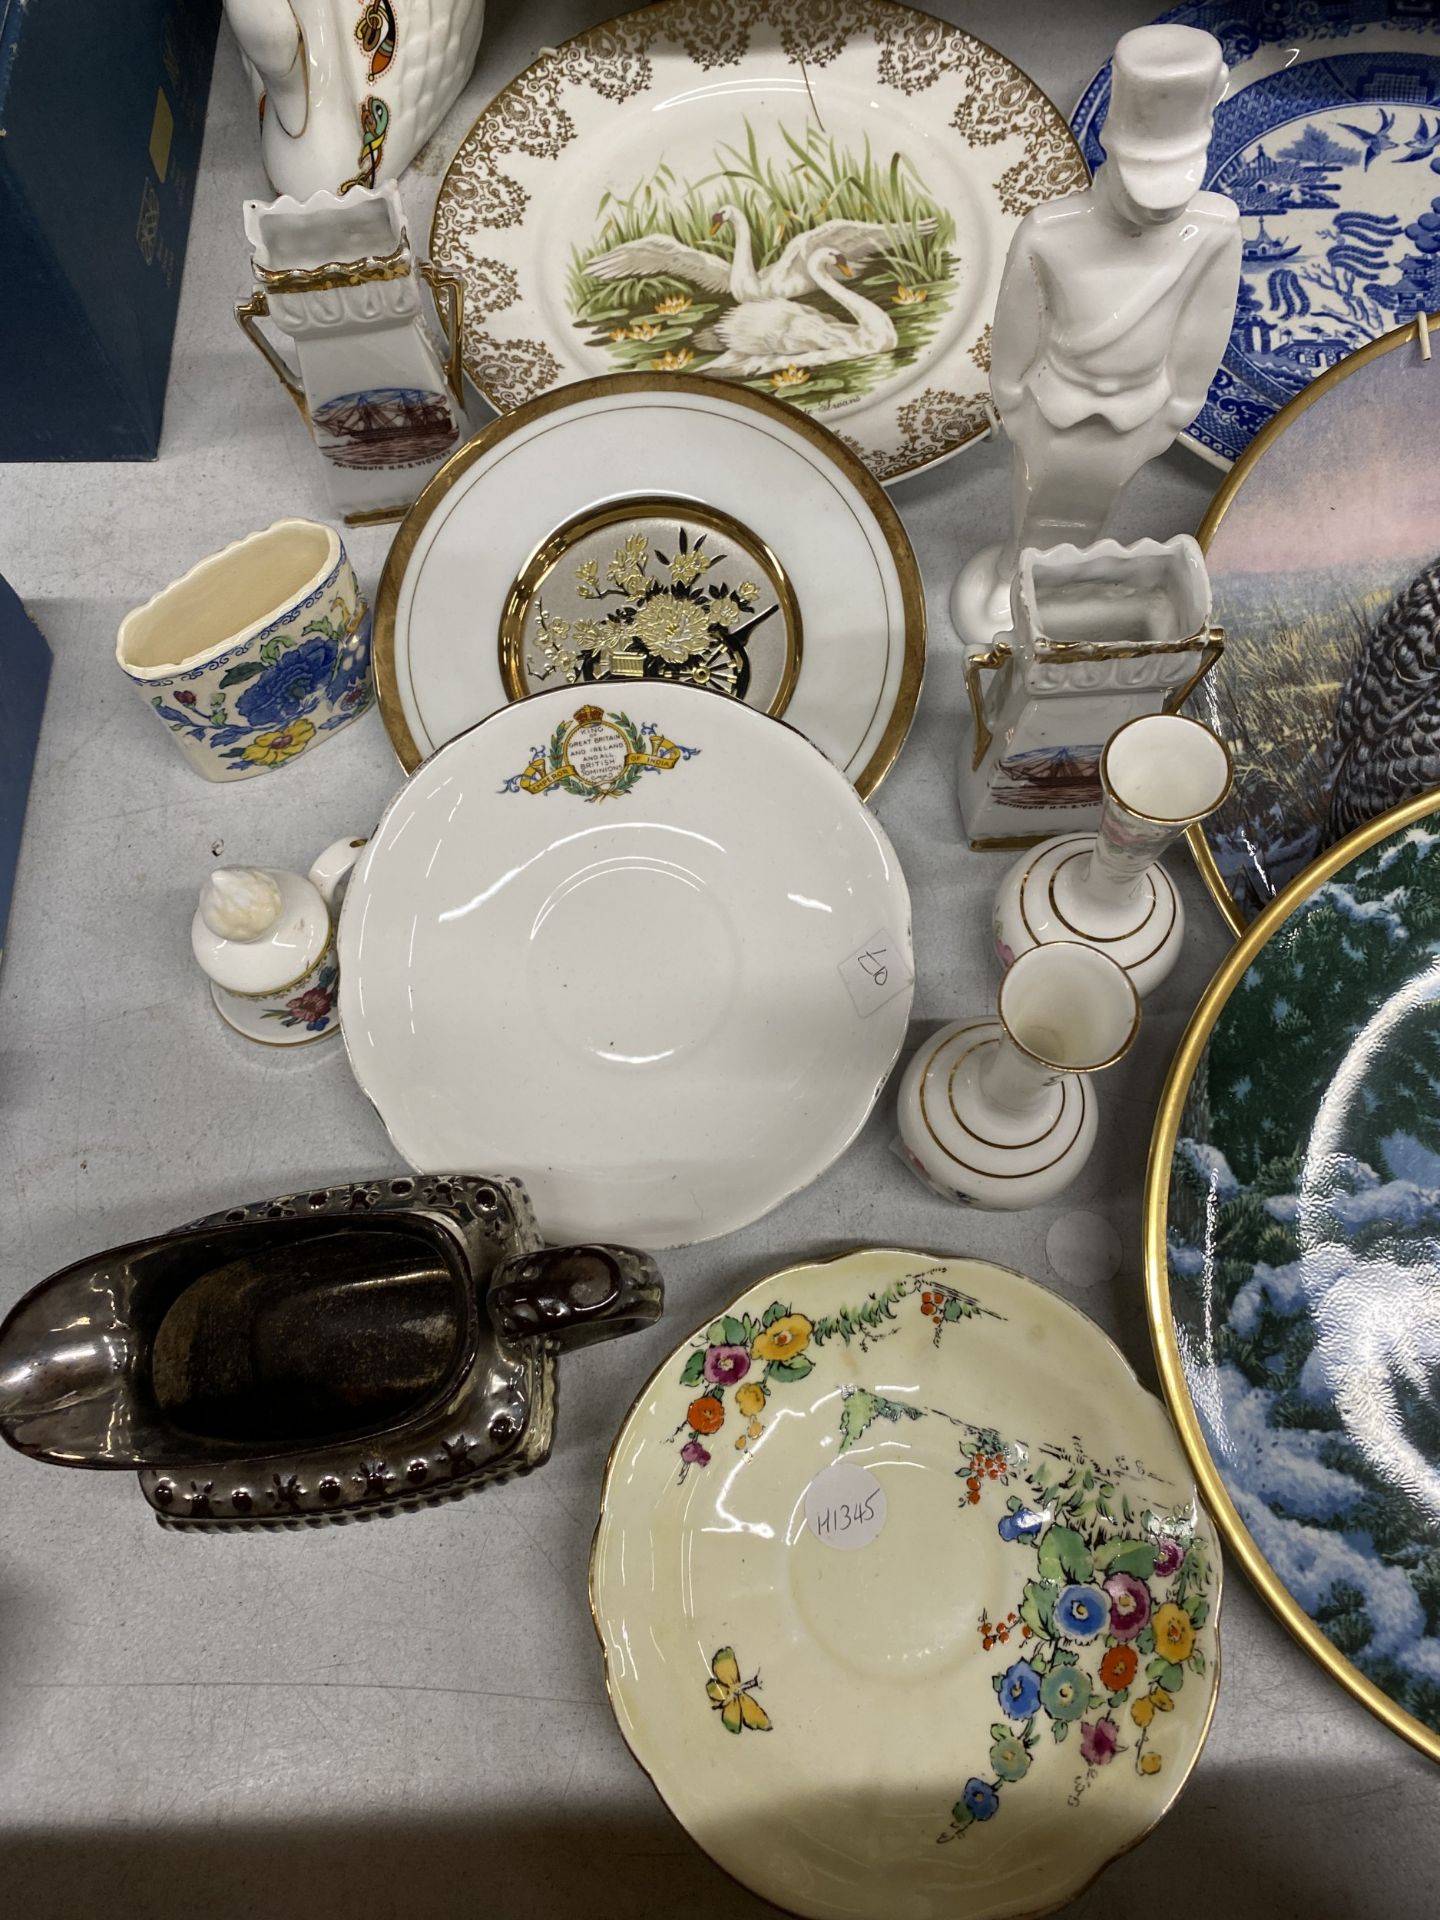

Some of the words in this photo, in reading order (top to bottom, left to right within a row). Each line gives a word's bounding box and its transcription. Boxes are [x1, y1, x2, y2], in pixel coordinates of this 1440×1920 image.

[580, 726, 604, 735] KING
[569, 739, 591, 748] GREAT
[594, 734, 621, 744] BRITAIN
[590, 742, 624, 753] IRELAND
[580, 759, 615, 770] BRITISH
[647, 757, 670, 767] INDIA
[533, 769, 568, 791] EMPEROR
[817, 1487, 881, 1535] H1345
